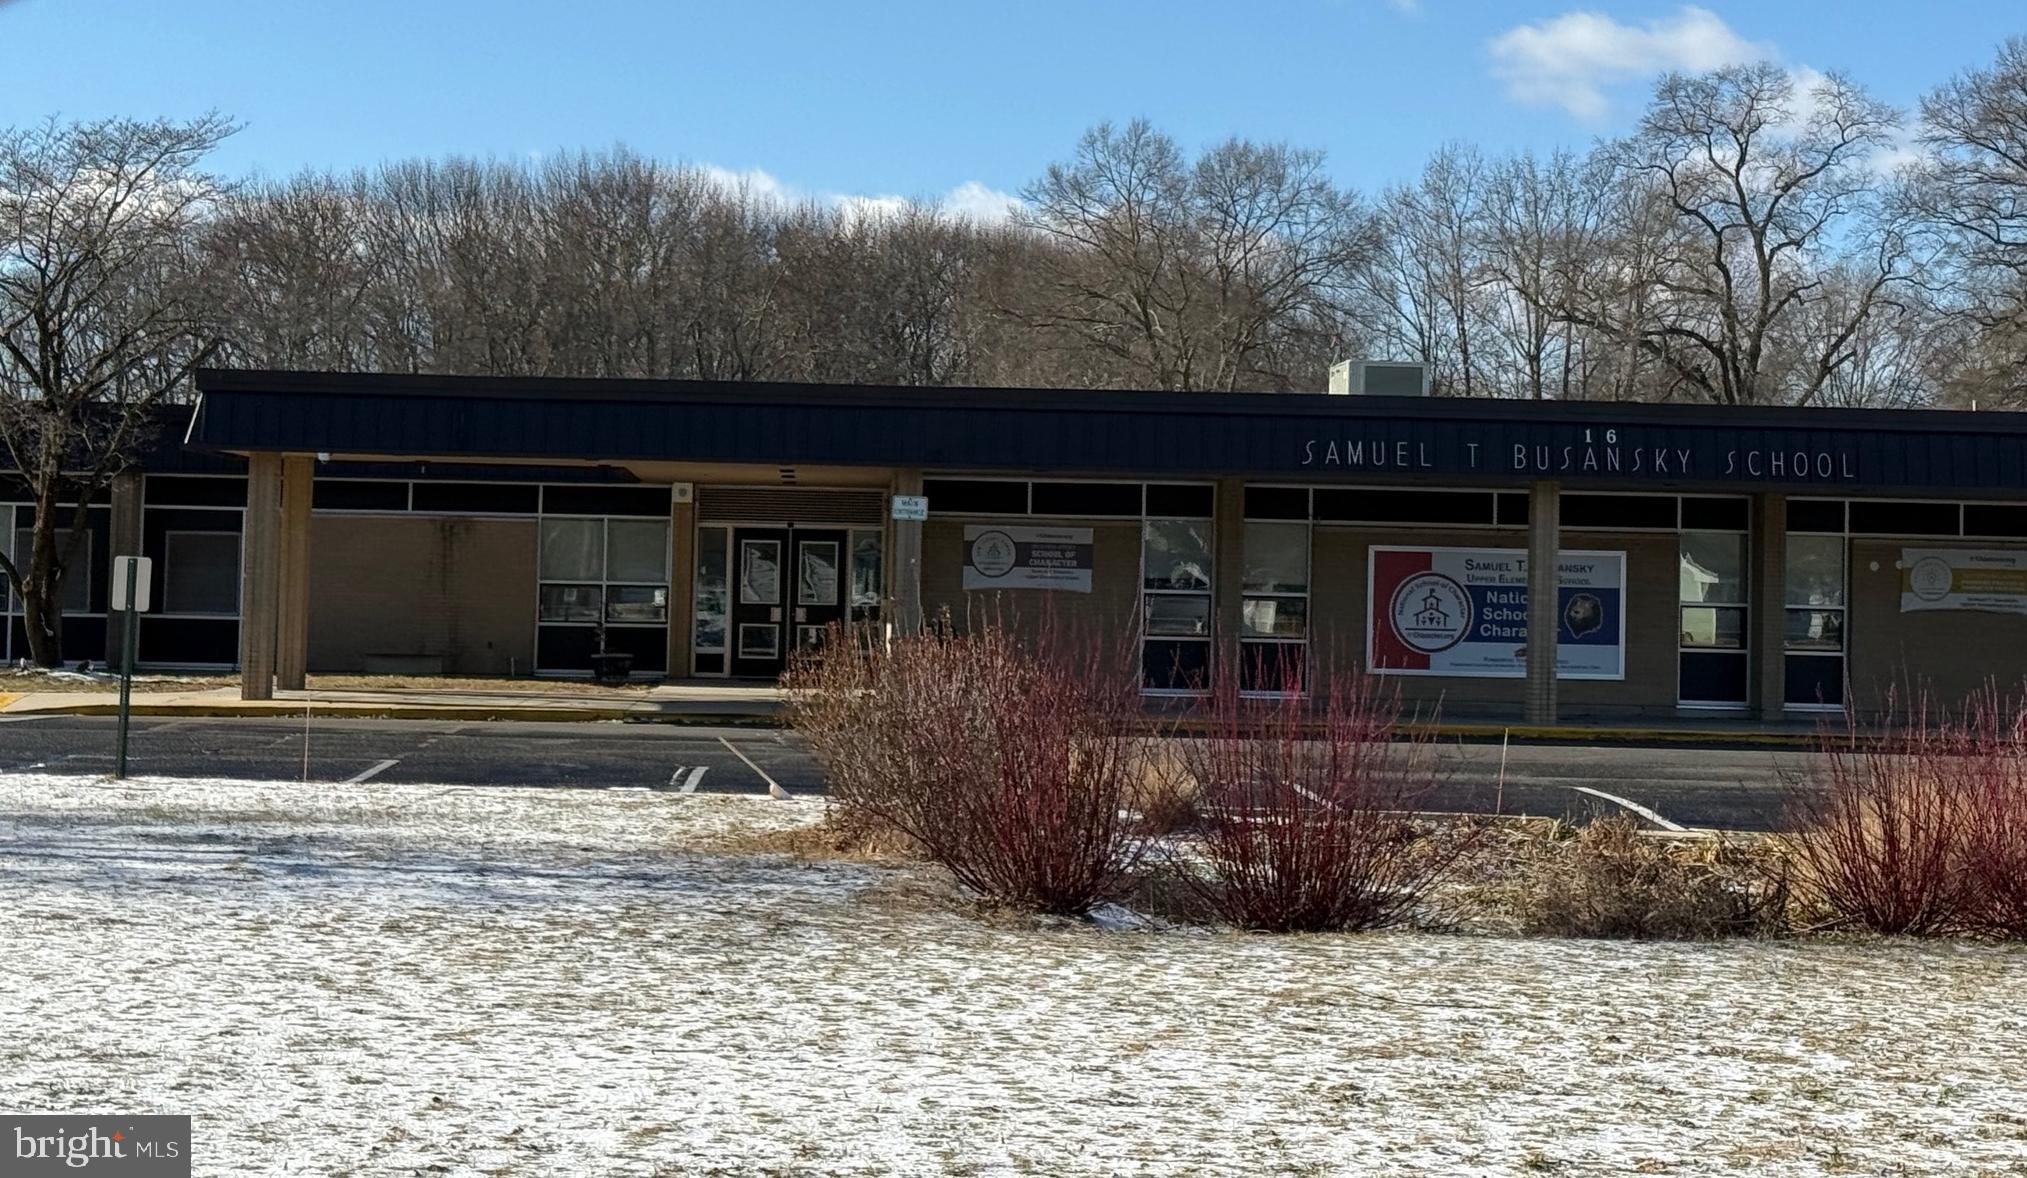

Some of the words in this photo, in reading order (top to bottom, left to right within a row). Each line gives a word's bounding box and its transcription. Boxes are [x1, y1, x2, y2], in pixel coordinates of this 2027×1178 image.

[1584, 428, 1617, 444] 16
[1301, 440, 1433, 469] SAMUEL
[1467, 443, 1480, 469] T
[1514, 443, 1692, 475] BUSANSKY
[1724, 450, 1855, 479] SCHOOL
[1031, 550, 1061, 558] SCHOOL
[1028, 558, 1078, 568] CHARACTER
[1464, 558, 1512, 572] SAMUEL
